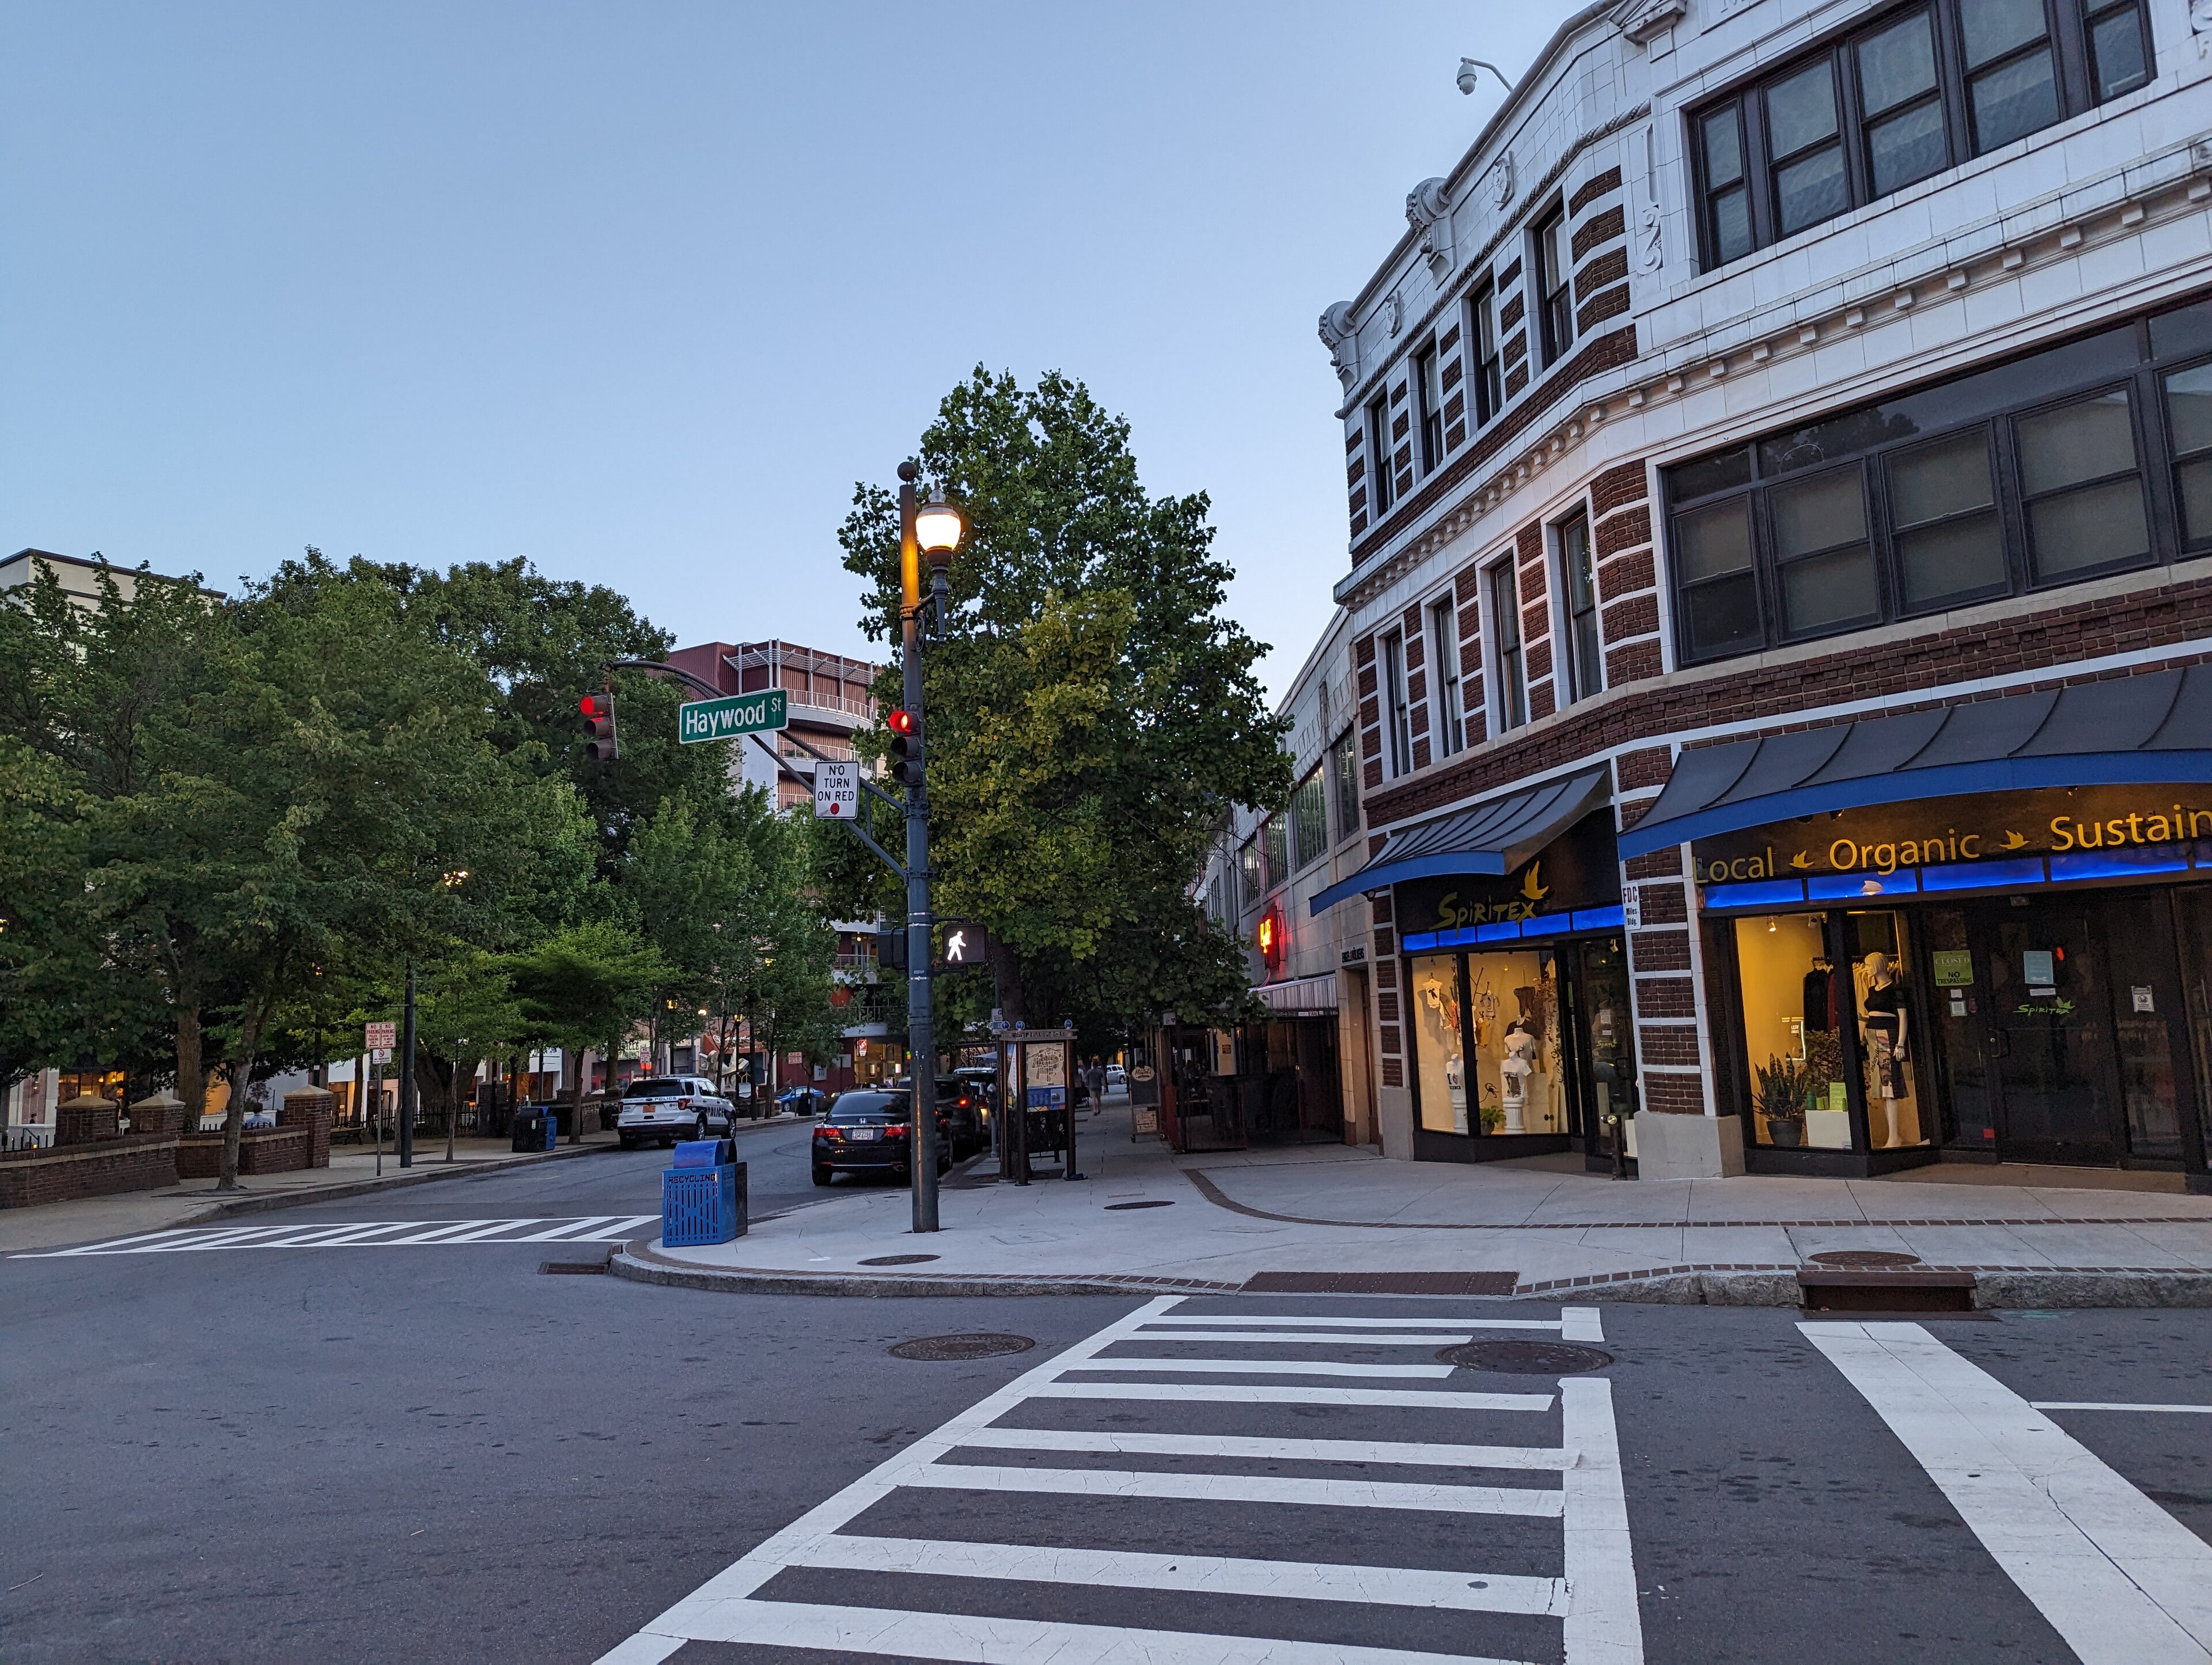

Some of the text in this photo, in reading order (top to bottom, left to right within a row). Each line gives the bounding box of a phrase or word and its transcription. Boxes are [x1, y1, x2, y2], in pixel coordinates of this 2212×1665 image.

[686, 697, 781, 737] Haywood St
[829, 765, 844, 775] NO
[824, 778, 849, 788] TURN
[818, 791, 854, 801] ON RED
[1692, 804, 2212, 883] Local Organic Sustain
[1622, 886, 1637, 904] FDC
[707, 1106, 724, 1117] POLICE
[668, 1173, 715, 1183] RECYCLING
